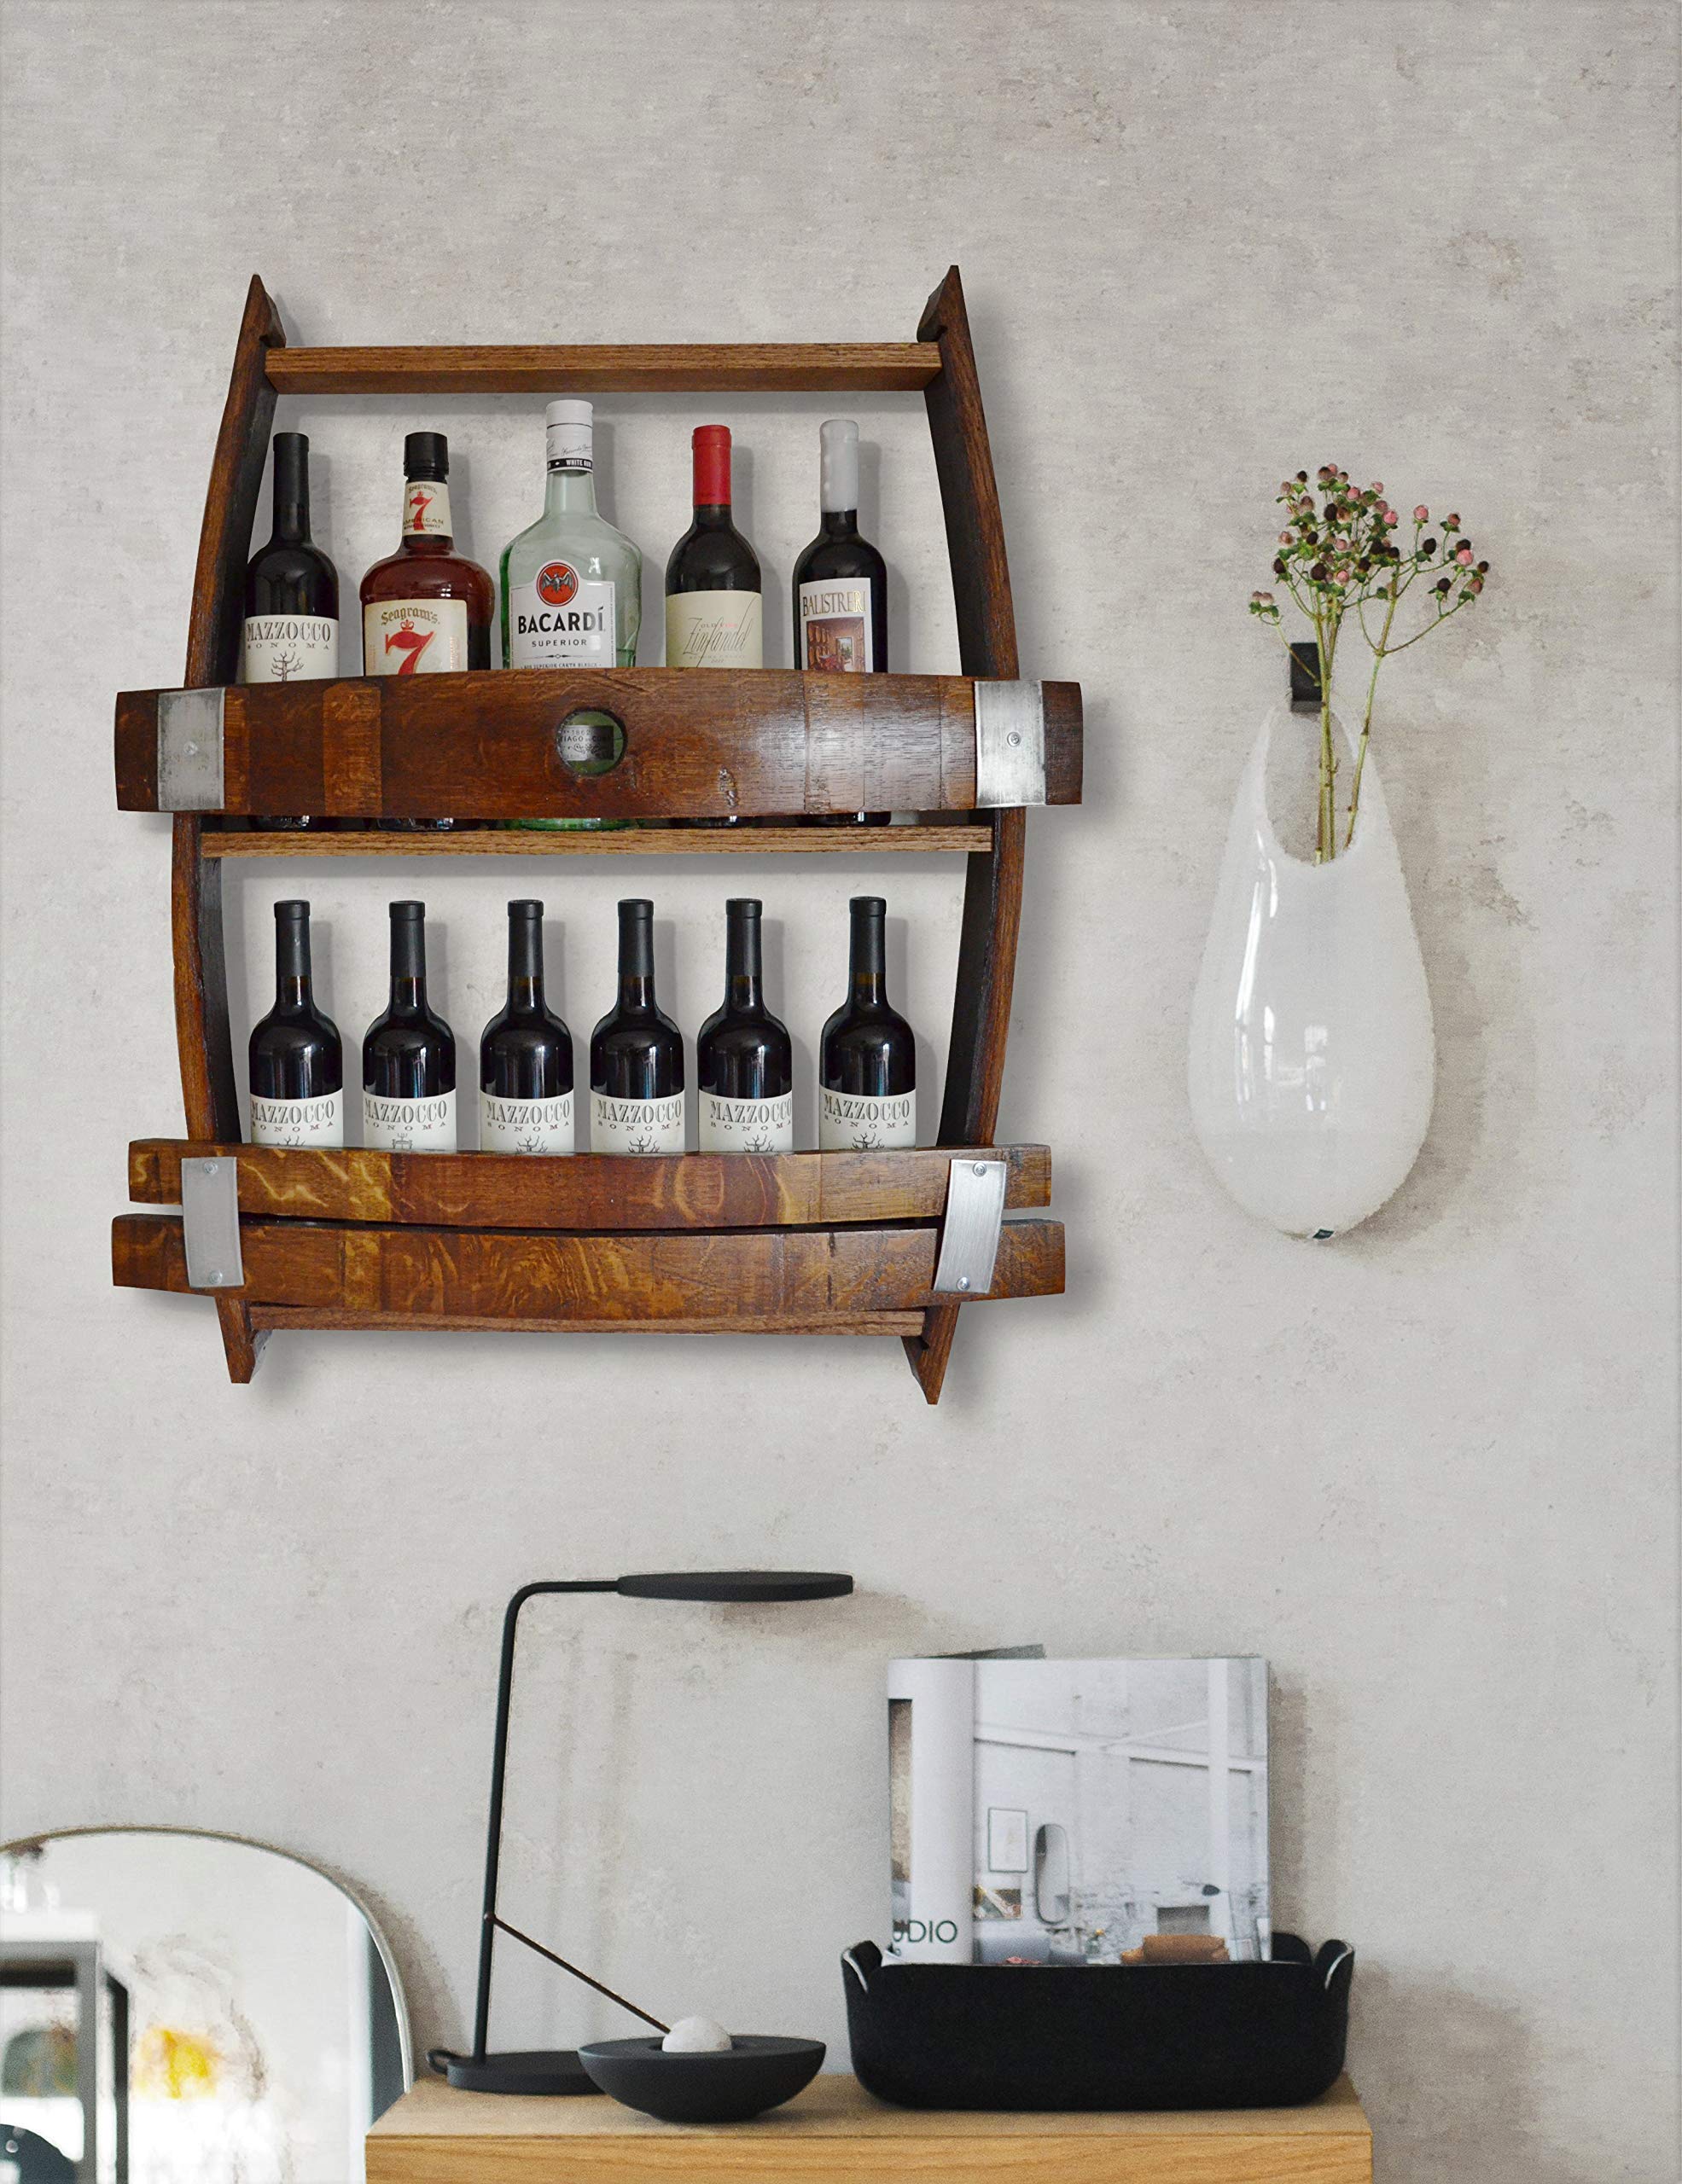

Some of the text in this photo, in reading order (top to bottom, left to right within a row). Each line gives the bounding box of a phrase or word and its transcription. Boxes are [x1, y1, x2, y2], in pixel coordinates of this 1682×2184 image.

[409, 497, 434, 531] 7
[381, 607, 438, 625] Seagram's
[803, 590, 866, 616] BALISTRERI
[247, 622, 331, 642] MAZZOCCO
[518, 606, 604, 634] BACARDÍ
[385, 631, 436, 674] 7
[251, 1100, 335, 1124] MAZZOCCO
[364, 1098, 447, 1124] MAZZOCCO
[486, 1099, 570, 1124] MAZZOCCO
[597, 1099, 682, 1124] MAZZOCCO
[710, 1098, 792, 1124] MAZZOCCO
[824, 1094, 910, 1121] MAZZOCCO
